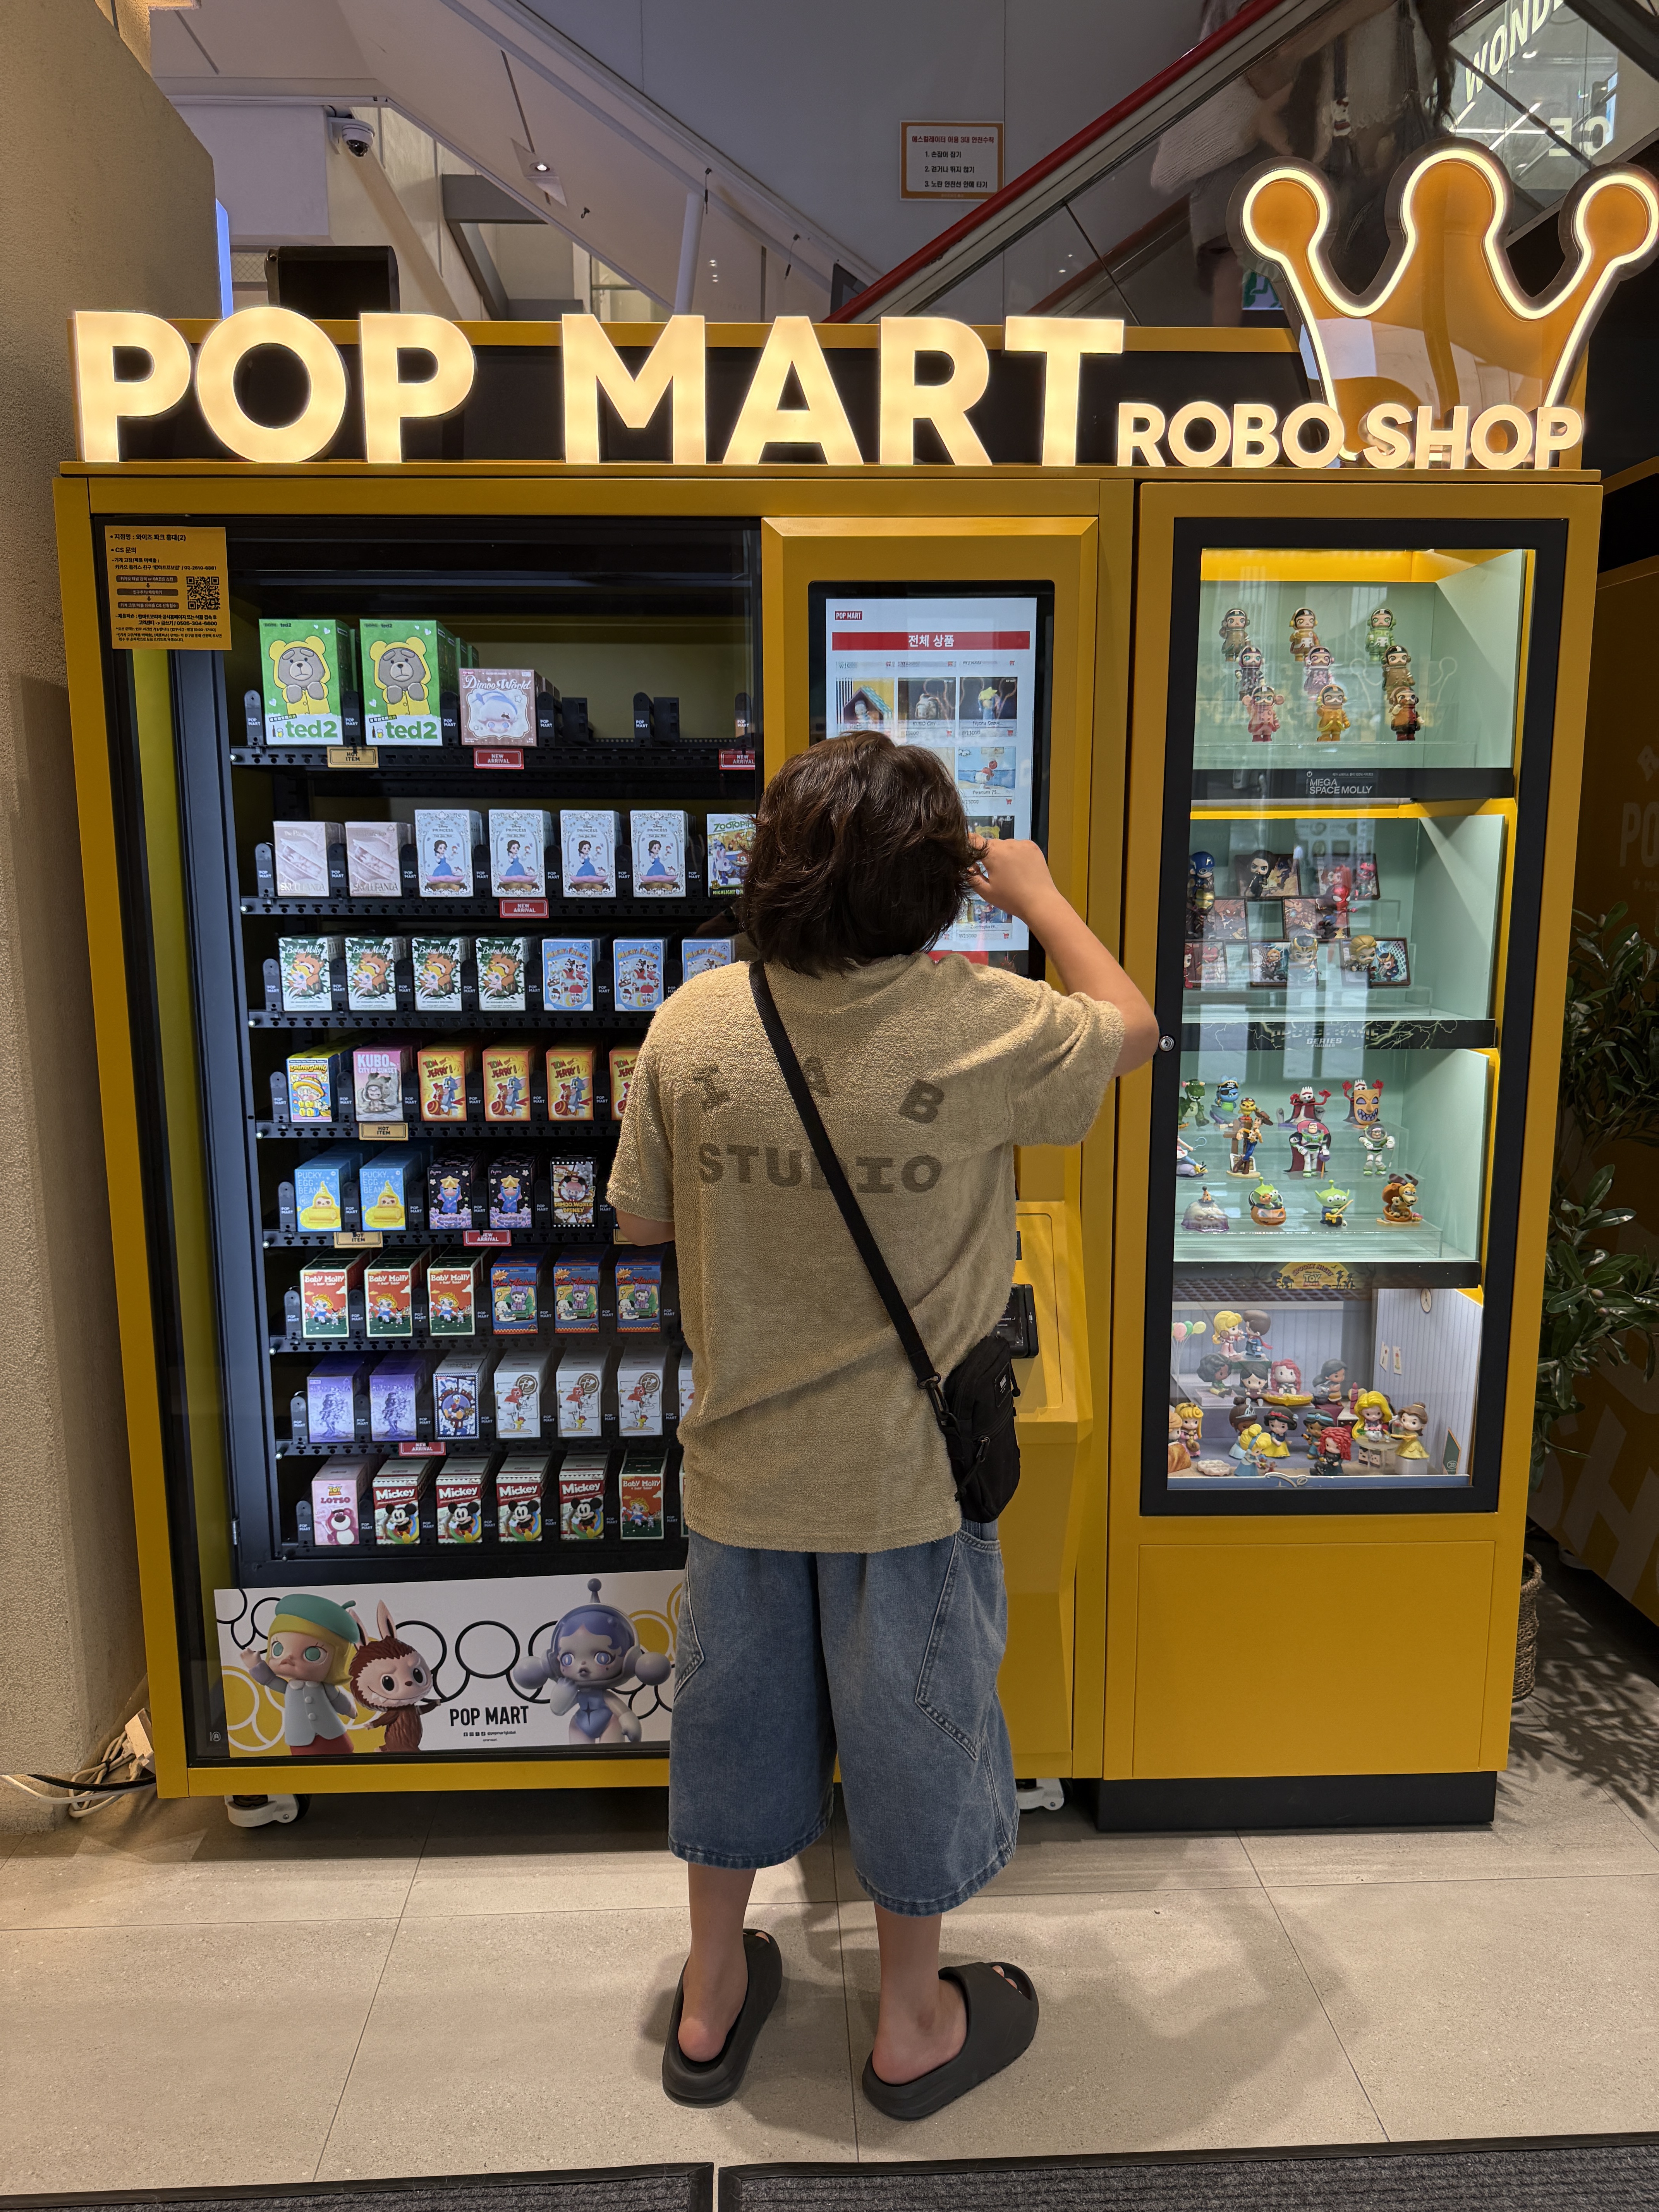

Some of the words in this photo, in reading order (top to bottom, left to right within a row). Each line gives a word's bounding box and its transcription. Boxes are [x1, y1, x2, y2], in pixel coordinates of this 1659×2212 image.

[1465, 0, 1564, 103] WOND
[75, 306, 477, 463] POP
[561, 314, 1124, 467] MART
[1117, 400, 1345, 469] ROBO
[1363, 403, 1583, 470] SHOP
[908, 635, 929, 647] 전체
[933, 635, 954, 647] 상품
[463, 675, 495, 689] Dimoo
[285, 720, 338, 738] ted2
[385, 721, 438, 739] ted2
[1309, 778, 1337, 787] MEGA
[1309, 786, 1340, 795] SPACE
[1341, 786, 1373, 794] MOLLY
[357, 1054, 390, 1067] KUBO
[422, 1060, 438, 1069] TOM
[487, 1060, 503, 1069] TOM
[551, 1060, 567, 1069] TOM
[614, 1059, 629, 1069] TOM
[427, 1066, 448, 1078] JERRY
[491, 1066, 513, 1078] JERRY
[555, 1067, 576, 1079] JERRY
[299, 1187, 325, 1195] BEANIE
[1292, 1264, 1316, 1277] SPOOKY
[1316, 1264, 1334, 1277] NIGHT
[1303, 1274, 1322, 1283] TOY
[438, 1486, 478, 1499] Mickey
[499, 1485, 538, 1498] Mickey
[562, 1482, 601, 1495] Mickey
[376, 1489, 415, 1501] Mickey
[450, 1708, 480, 1726] POP
[485, 1705, 529, 1725] MART
